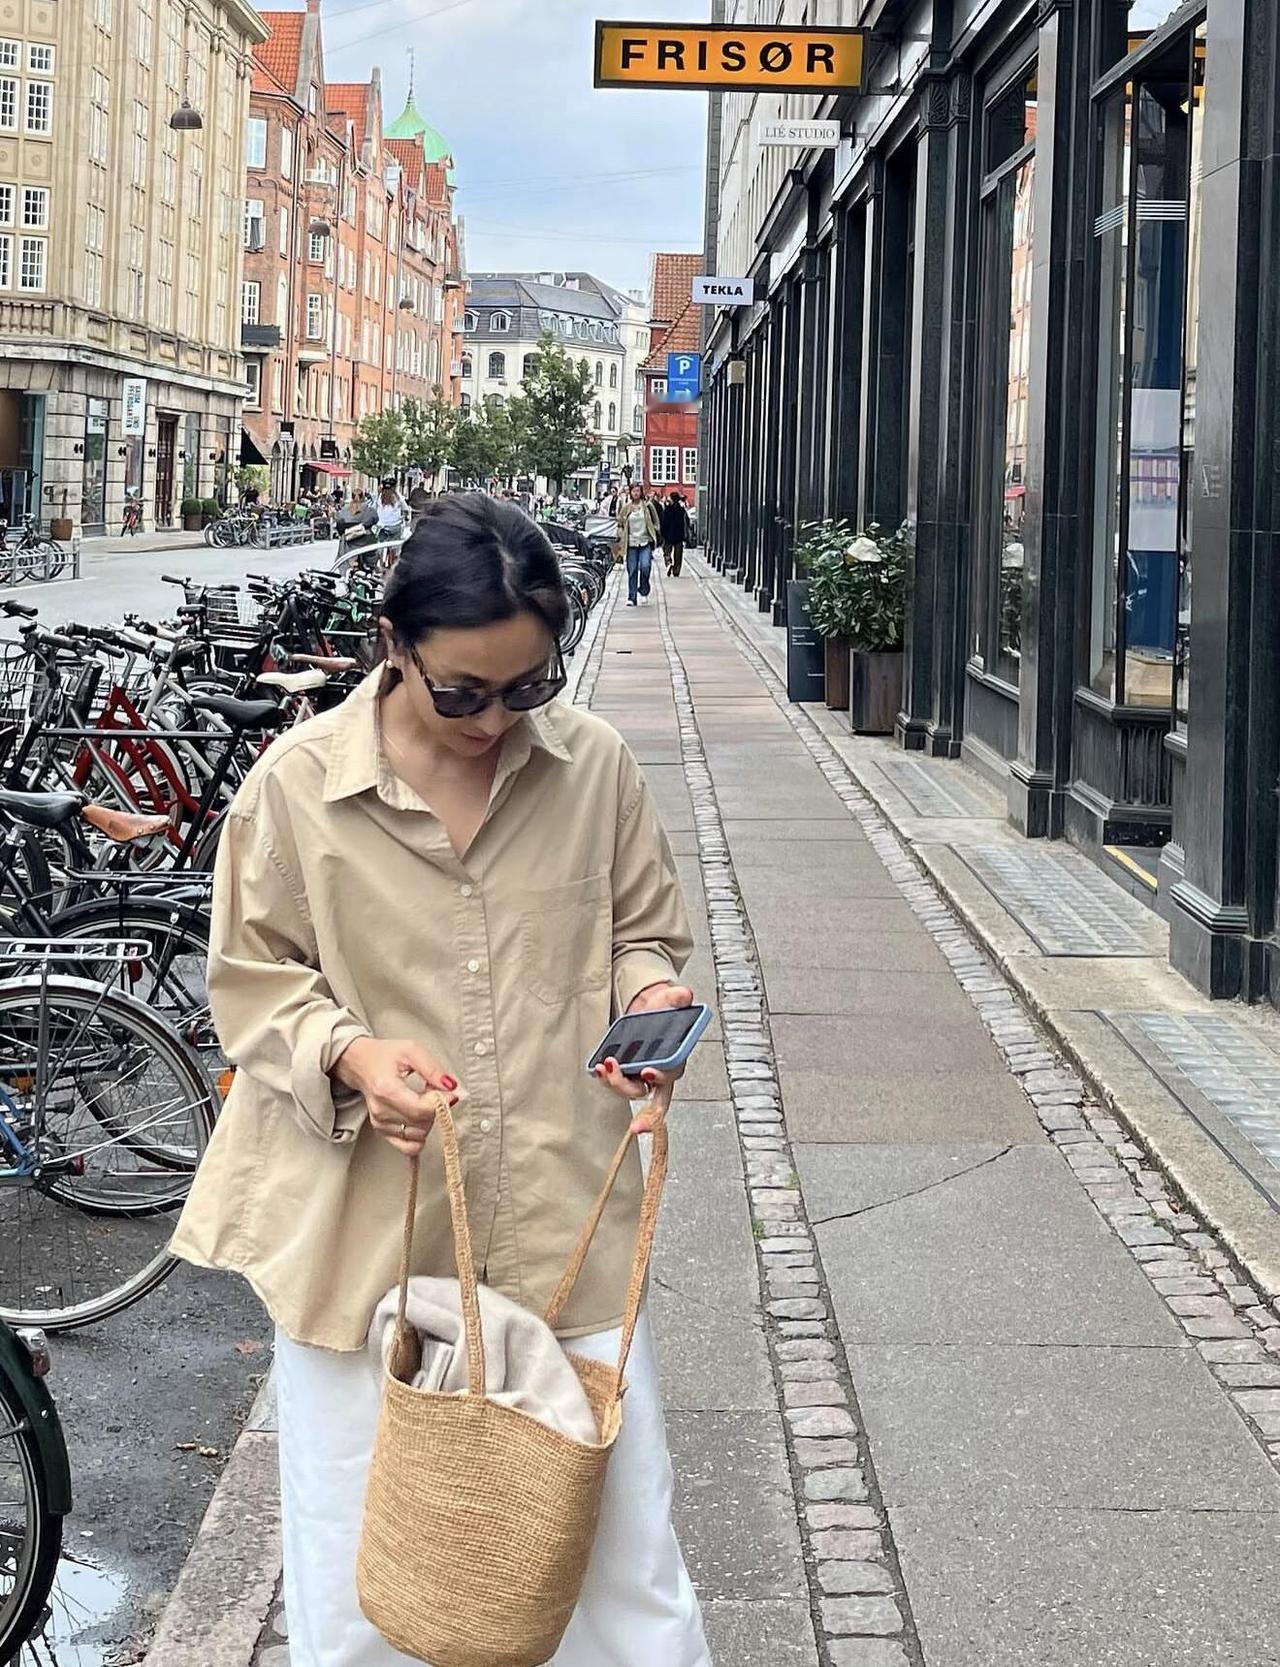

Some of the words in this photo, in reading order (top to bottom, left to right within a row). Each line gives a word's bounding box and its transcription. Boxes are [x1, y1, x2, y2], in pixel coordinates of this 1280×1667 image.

[621, 39, 835, 73] FRISØR
[765, 124, 786, 138] LIÉ
[788, 127, 836, 139] STUDIO
[703, 285, 743, 296] TEKLA
[679, 359, 690, 375] P
[601, 462, 610, 472] P
